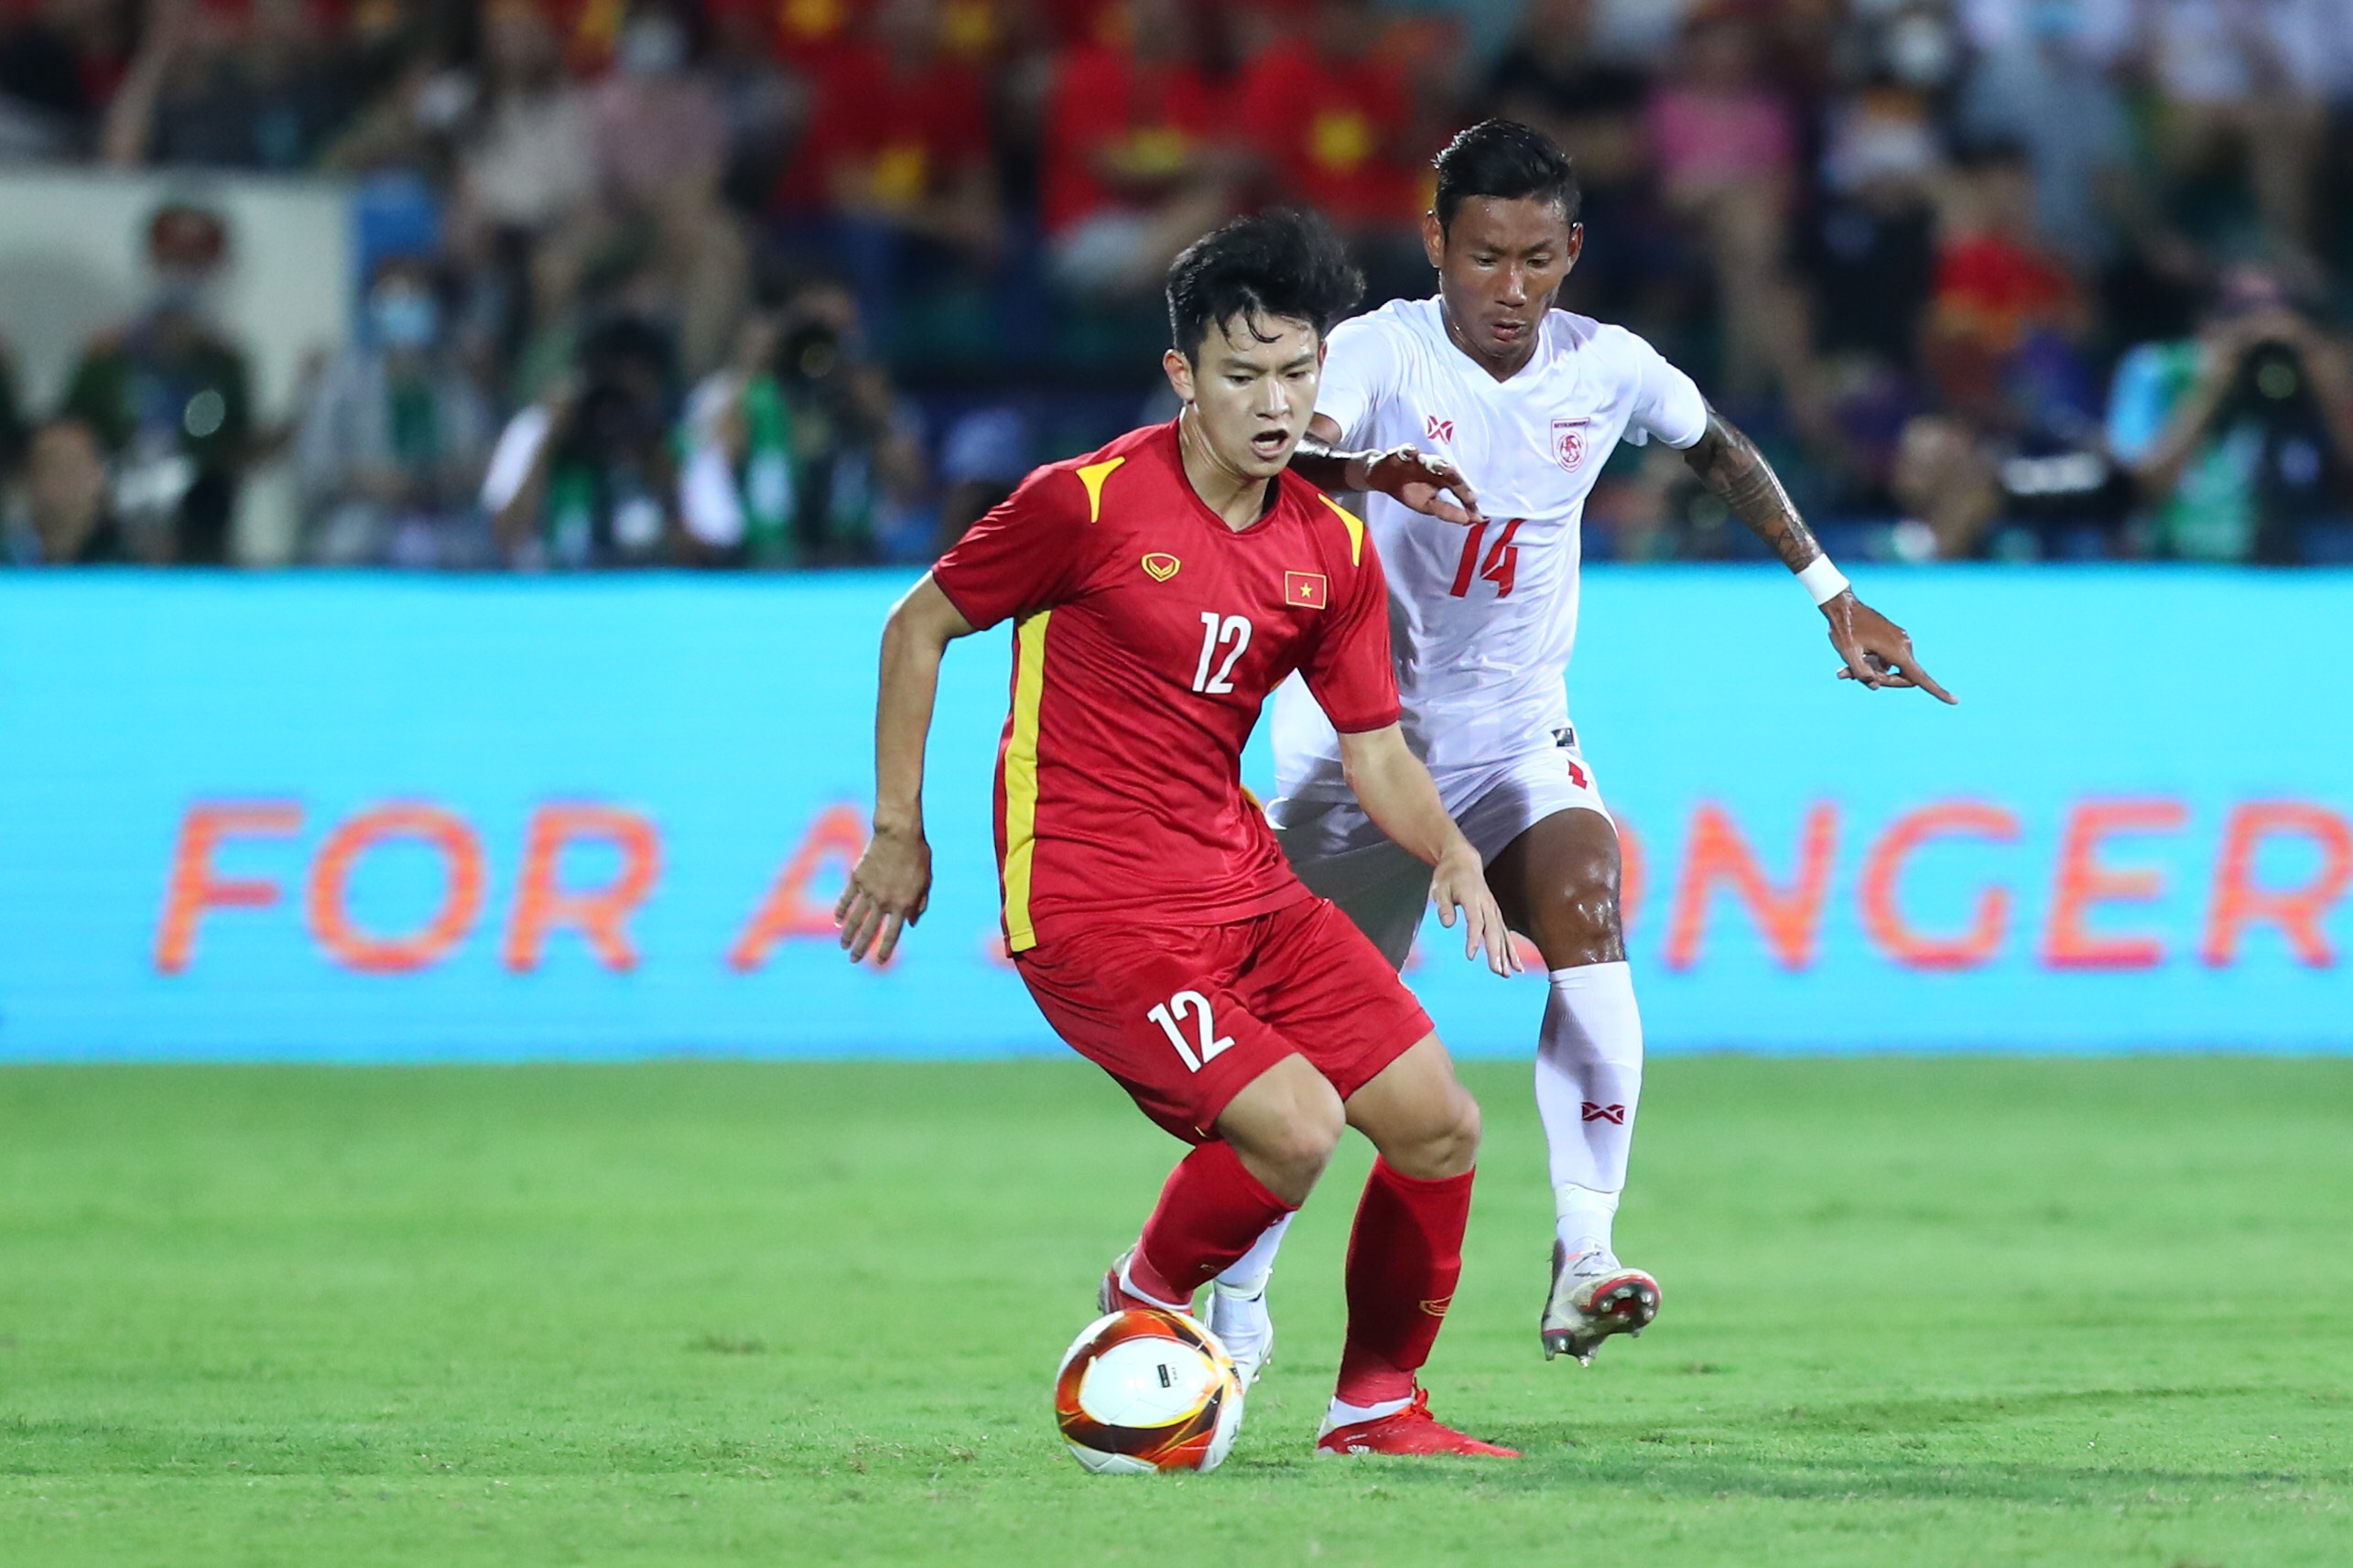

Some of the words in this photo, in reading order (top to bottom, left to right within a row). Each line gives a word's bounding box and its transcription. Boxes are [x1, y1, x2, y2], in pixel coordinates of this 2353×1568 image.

[1450, 518, 1526, 598] 14
[1192, 611, 1252, 694] 12
[153, 798, 666, 974] FOR
[725, 801, 899, 972] A
[1146, 989, 1236, 1073] 12
